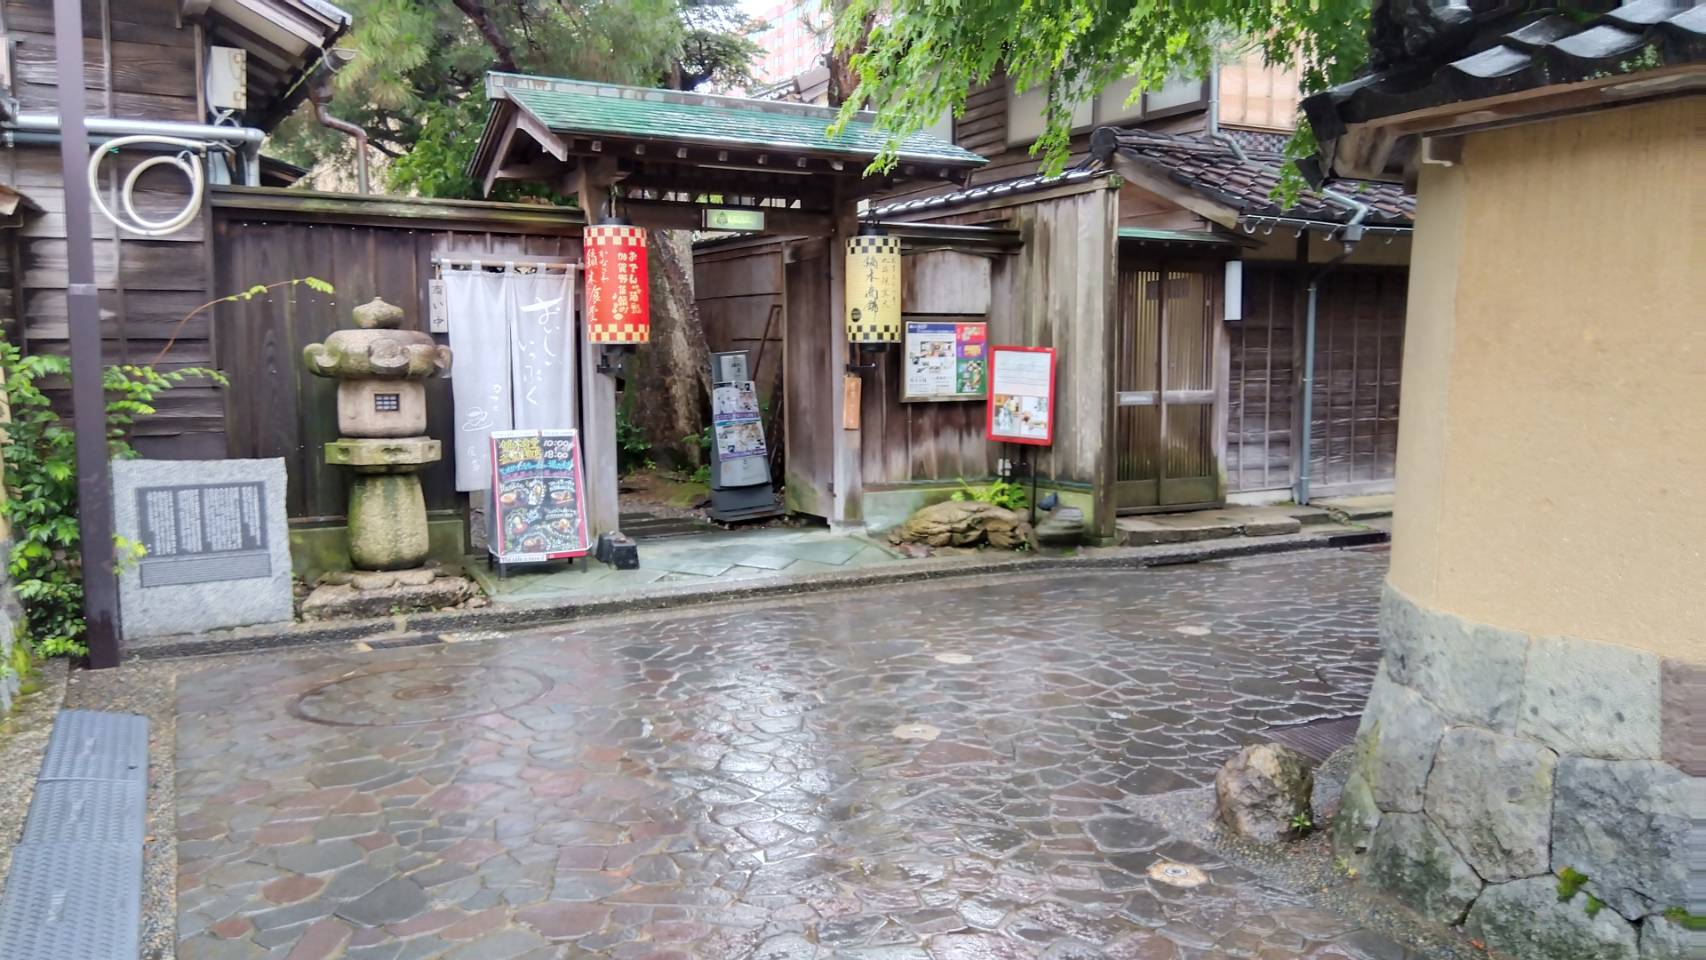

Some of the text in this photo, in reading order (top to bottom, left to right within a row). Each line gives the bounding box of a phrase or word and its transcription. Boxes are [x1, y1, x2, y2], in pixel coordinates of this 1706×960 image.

[431, 285, 445, 328] 商い中
[543, 439, 569, 447] 10:00
[543, 449, 569, 459] 18:00
